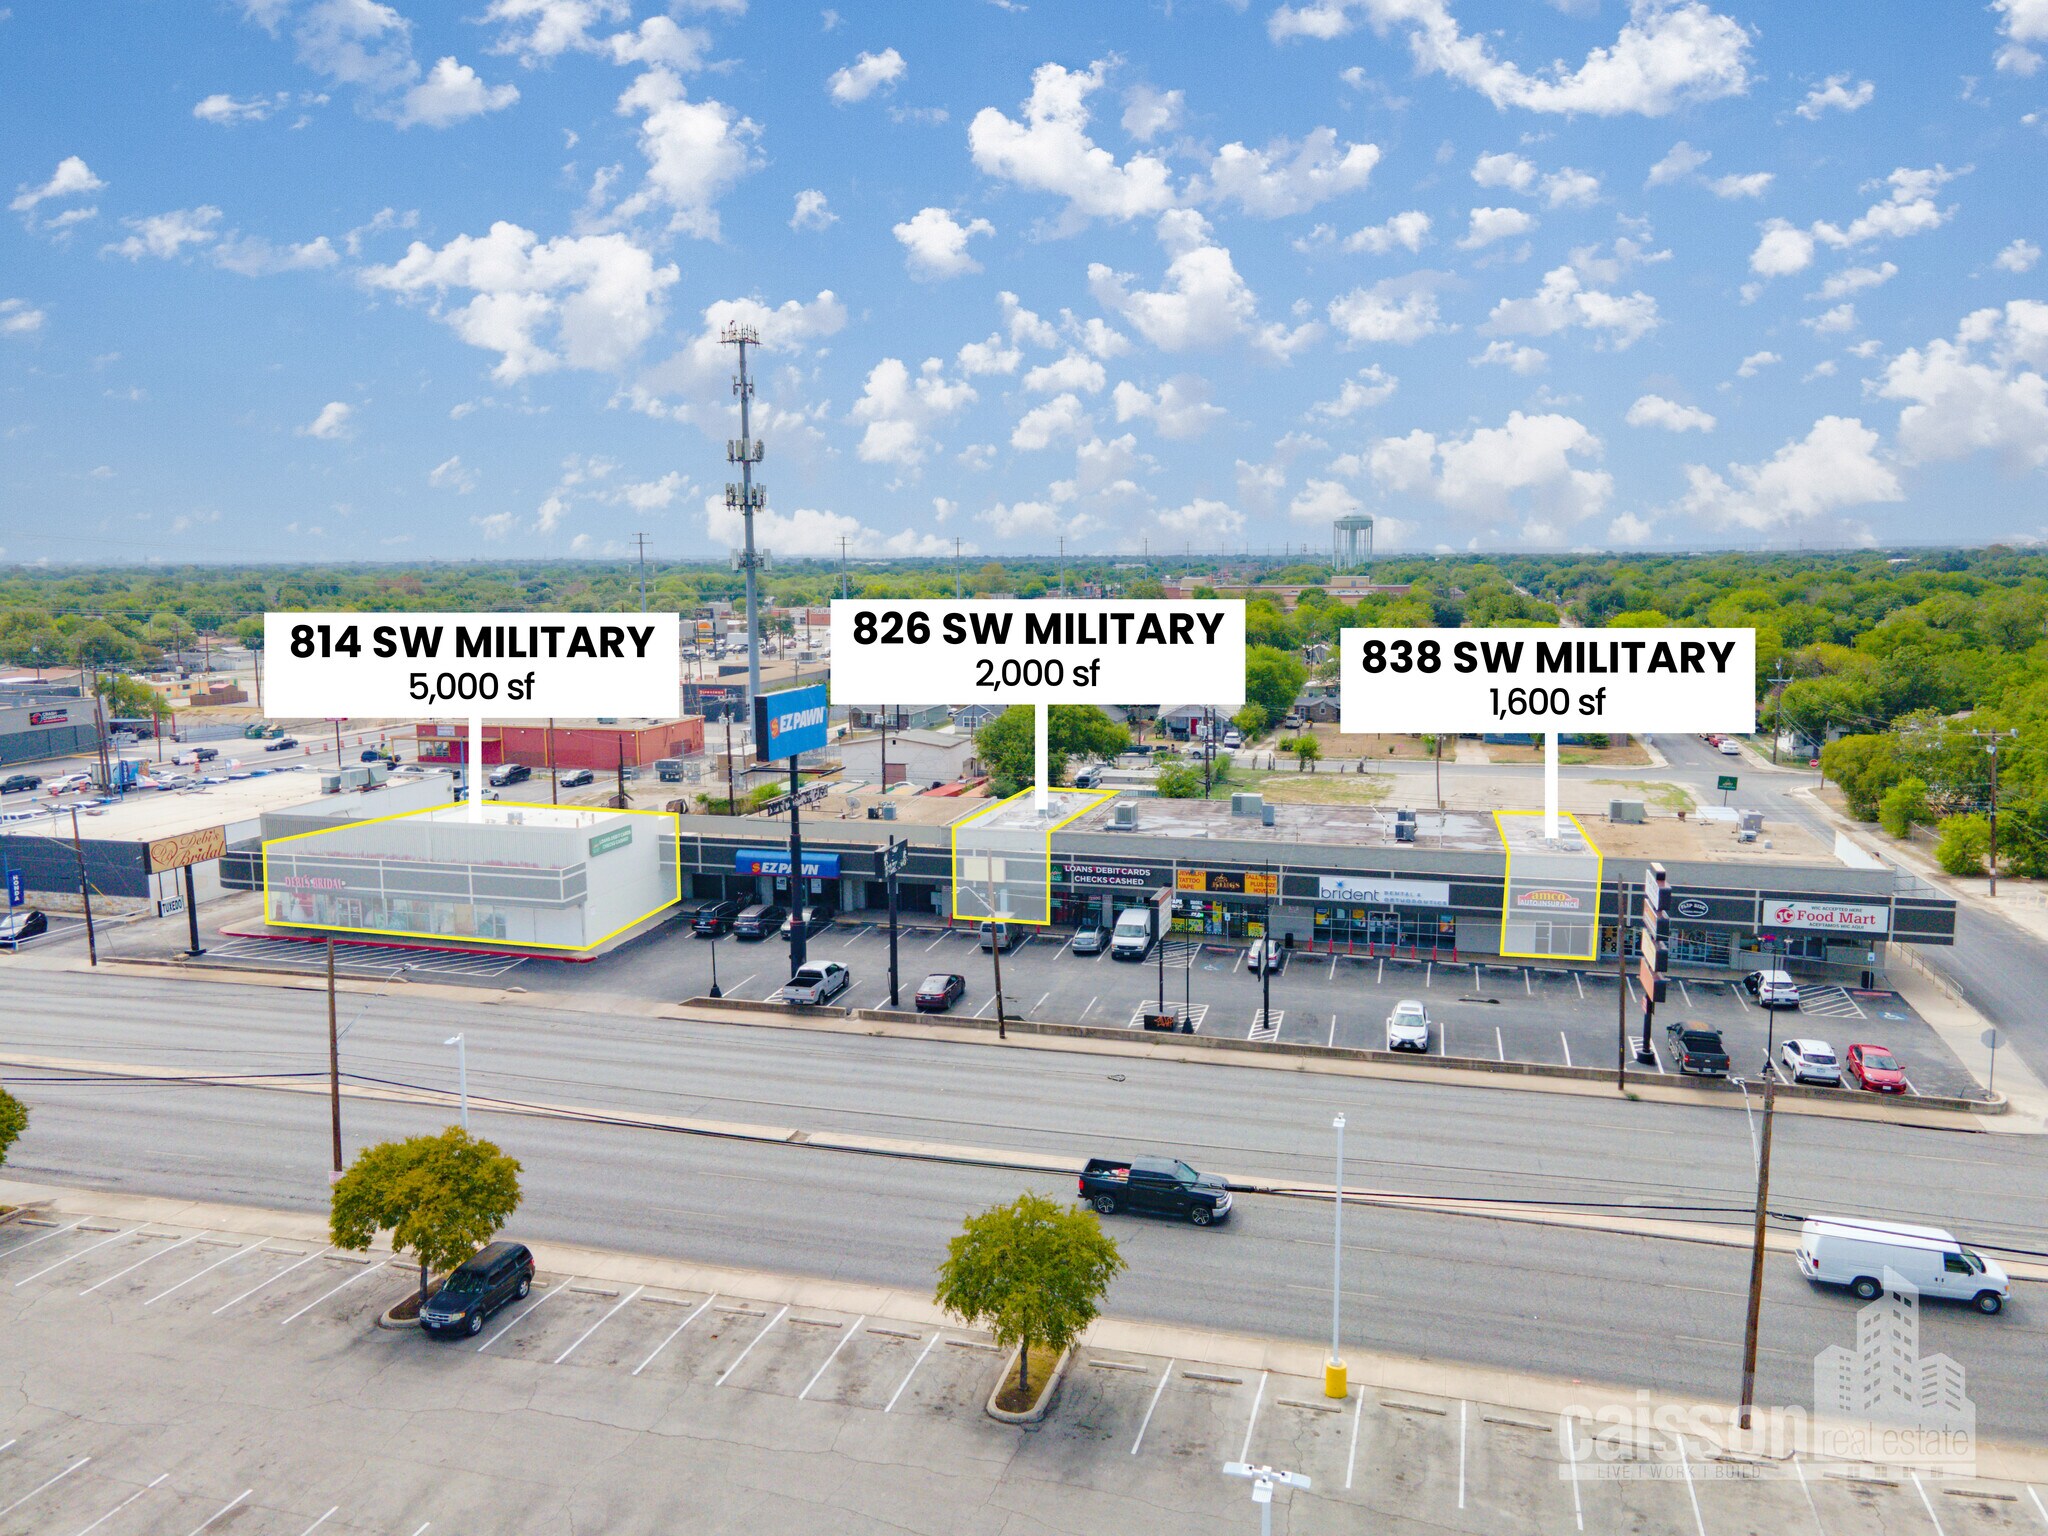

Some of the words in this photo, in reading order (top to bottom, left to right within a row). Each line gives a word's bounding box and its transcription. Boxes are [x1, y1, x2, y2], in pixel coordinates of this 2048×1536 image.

[179, 829, 220, 849] Debi's
[173, 841, 225, 867] Bridal
[1064, 865, 1093, 873] LOANS
[1095, 866, 1120, 875] DEBIT
[1121, 868, 1151, 876] CARDS
[12, 874, 20, 902] HONDA
[285, 874, 311, 889] DEBI'S
[312, 878, 342, 889] BRIDAL
[1074, 875, 1108, 883] CHECKS
[1109, 877, 1144, 885] CASHED
[1321, 886, 1380, 902] brident
[1532, 892, 1566, 901] amco
[162, 898, 183, 914] TUXEDO
[1540, 900, 1578, 908] INSURANCE
[1796, 909, 1834, 922] Food
[1838, 912, 1876, 925] Mart
